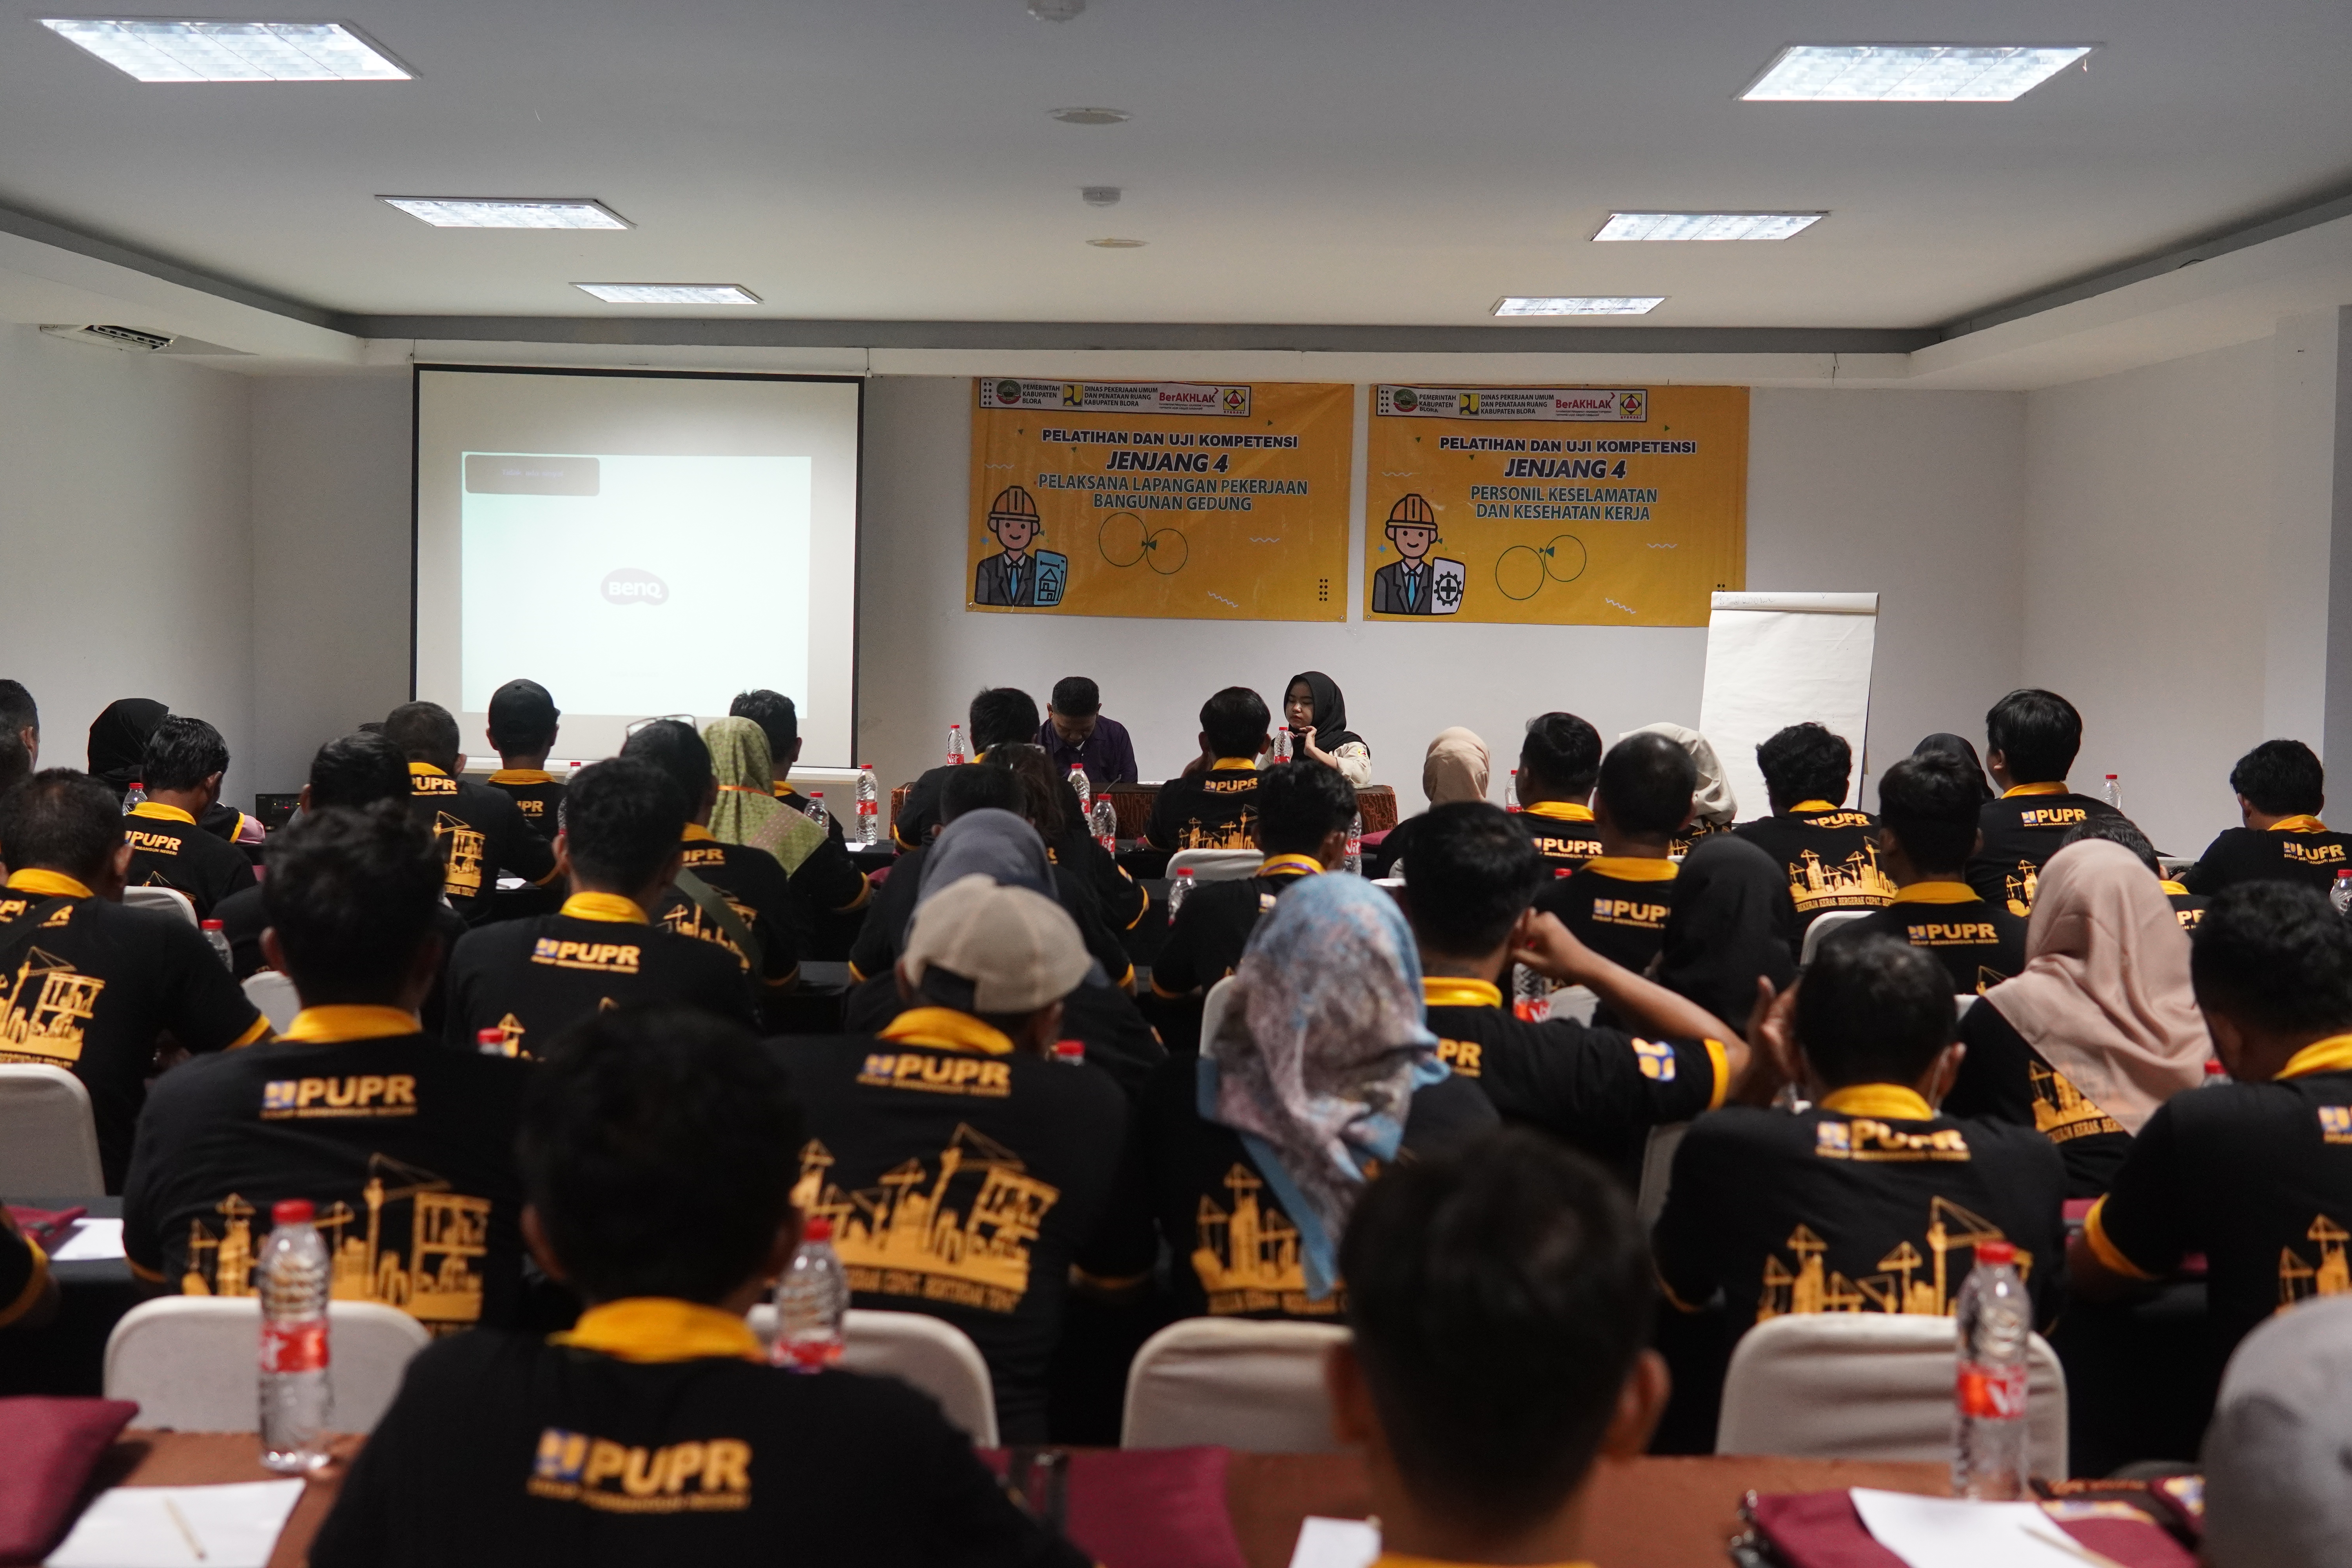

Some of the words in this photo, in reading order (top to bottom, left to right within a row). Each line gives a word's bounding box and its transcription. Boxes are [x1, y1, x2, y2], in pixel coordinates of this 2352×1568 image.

[1160, 392, 1215, 403] BerAKHLAK
[1556, 399, 1612, 409] BerAKHLAK
[1043, 430, 1128, 443] PELATIHAN
[1133, 433, 1164, 445] DAN
[1170, 434, 1194, 446] UJI
[1200, 435, 1298, 448] KOMPETENSI
[1440, 437, 1525, 451] PELATIHAN
[1530, 440, 1561, 452] DAN
[1567, 441, 1591, 452] UJI
[1597, 441, 1696, 453] KOMPETENSI
[1107, 451, 1209, 472] JENJANG
[1213, 454, 1228, 473] 4
[1505, 458, 1607, 478] JENJANG
[1611, 460, 1626, 479] 4
[1039, 474, 1129, 491] PELAKSANA
[1133, 476, 1217, 493] LAPANGAN
[1221, 480, 1308, 495] PEKERJAAN
[1094, 494, 1182, 510] BANGUNAN
[1187, 497, 1251, 510] GEDUNG
[1471, 486, 1545, 501] PERSONIL
[1549, 488, 1657, 503] KESELAMATAN
[1476, 504, 1512, 518] DAN
[1514, 505, 1601, 520] KESEHATAN
[1605, 506, 1650, 521] KERJA
[609, 582, 662, 598] BenQ
[948, 755, 959, 763] Vit
[412, 777, 457, 790] UPR
[1216, 778, 1258, 791] PUPR
[517, 800, 543, 812] PR
[1817, 813, 1870, 826] PUPR
[2036, 809, 2087, 823] PUPR
[129, 831, 181, 851] PUPR
[1346, 840, 1360, 854] Vit
[1543, 838, 1603, 855] PUPR
[683, 849, 724, 862] PR
[2299, 857, 2328, 865] MEANGUN
[1838, 896, 1865, 906] BERGERAK
[1613, 900, 1671, 921] PUP
[1927, 924, 1997, 940] PUPR
[557, 941, 641, 965] PUPR
[1437, 1038, 1482, 1067] PR
[895, 1054, 1011, 1086] PUPR
[295, 1076, 416, 1107] PUPR
[582, 1436, 752, 1496] PUPR
